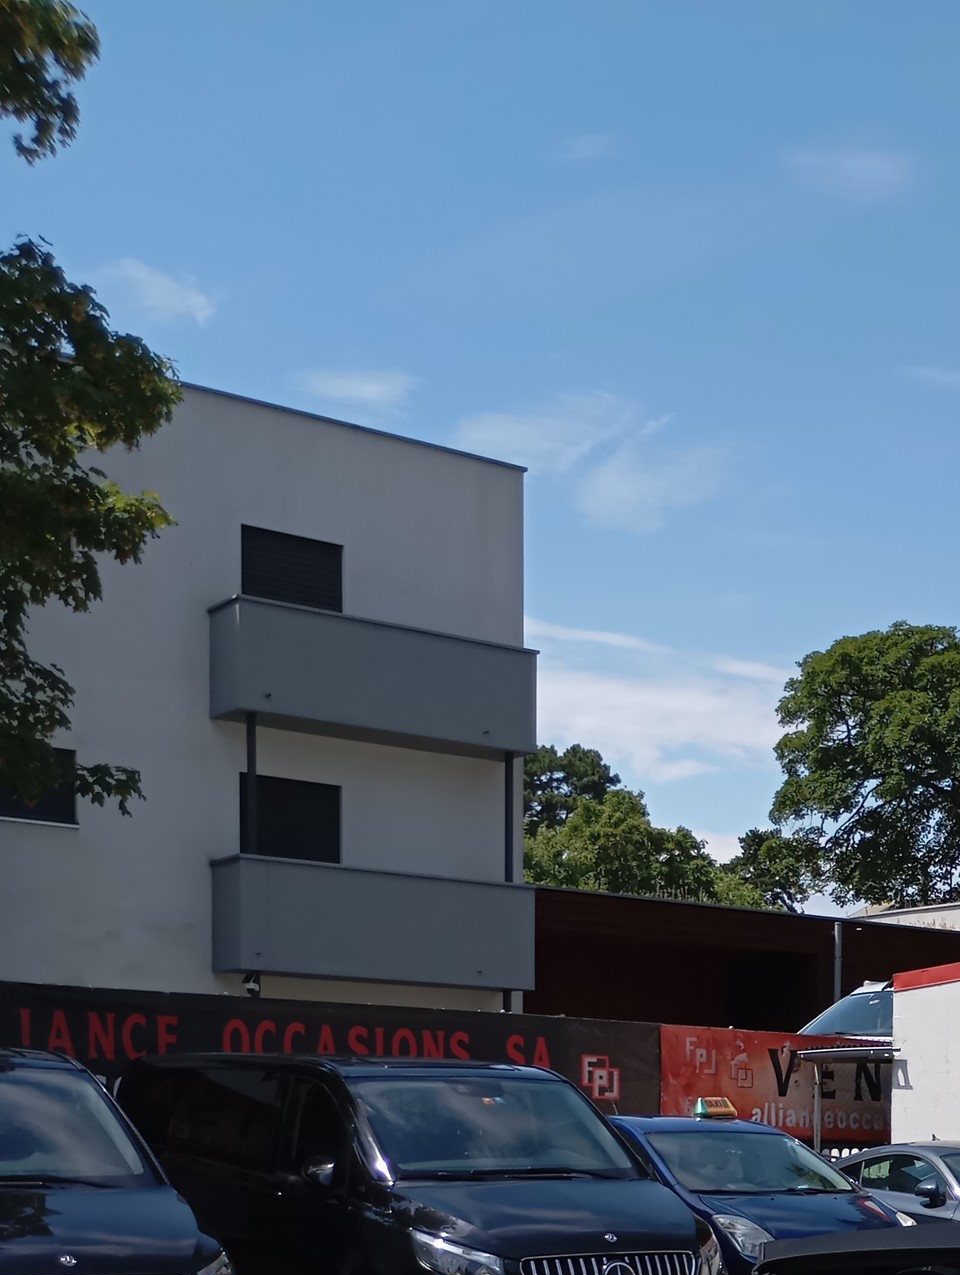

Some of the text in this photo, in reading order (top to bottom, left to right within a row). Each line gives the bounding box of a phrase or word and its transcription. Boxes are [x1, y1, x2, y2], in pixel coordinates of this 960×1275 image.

[223, 1019, 470, 1060] OCCASIONS
[506, 1034, 550, 1068] SA
[751, 1103, 891, 1131] allianeocca
